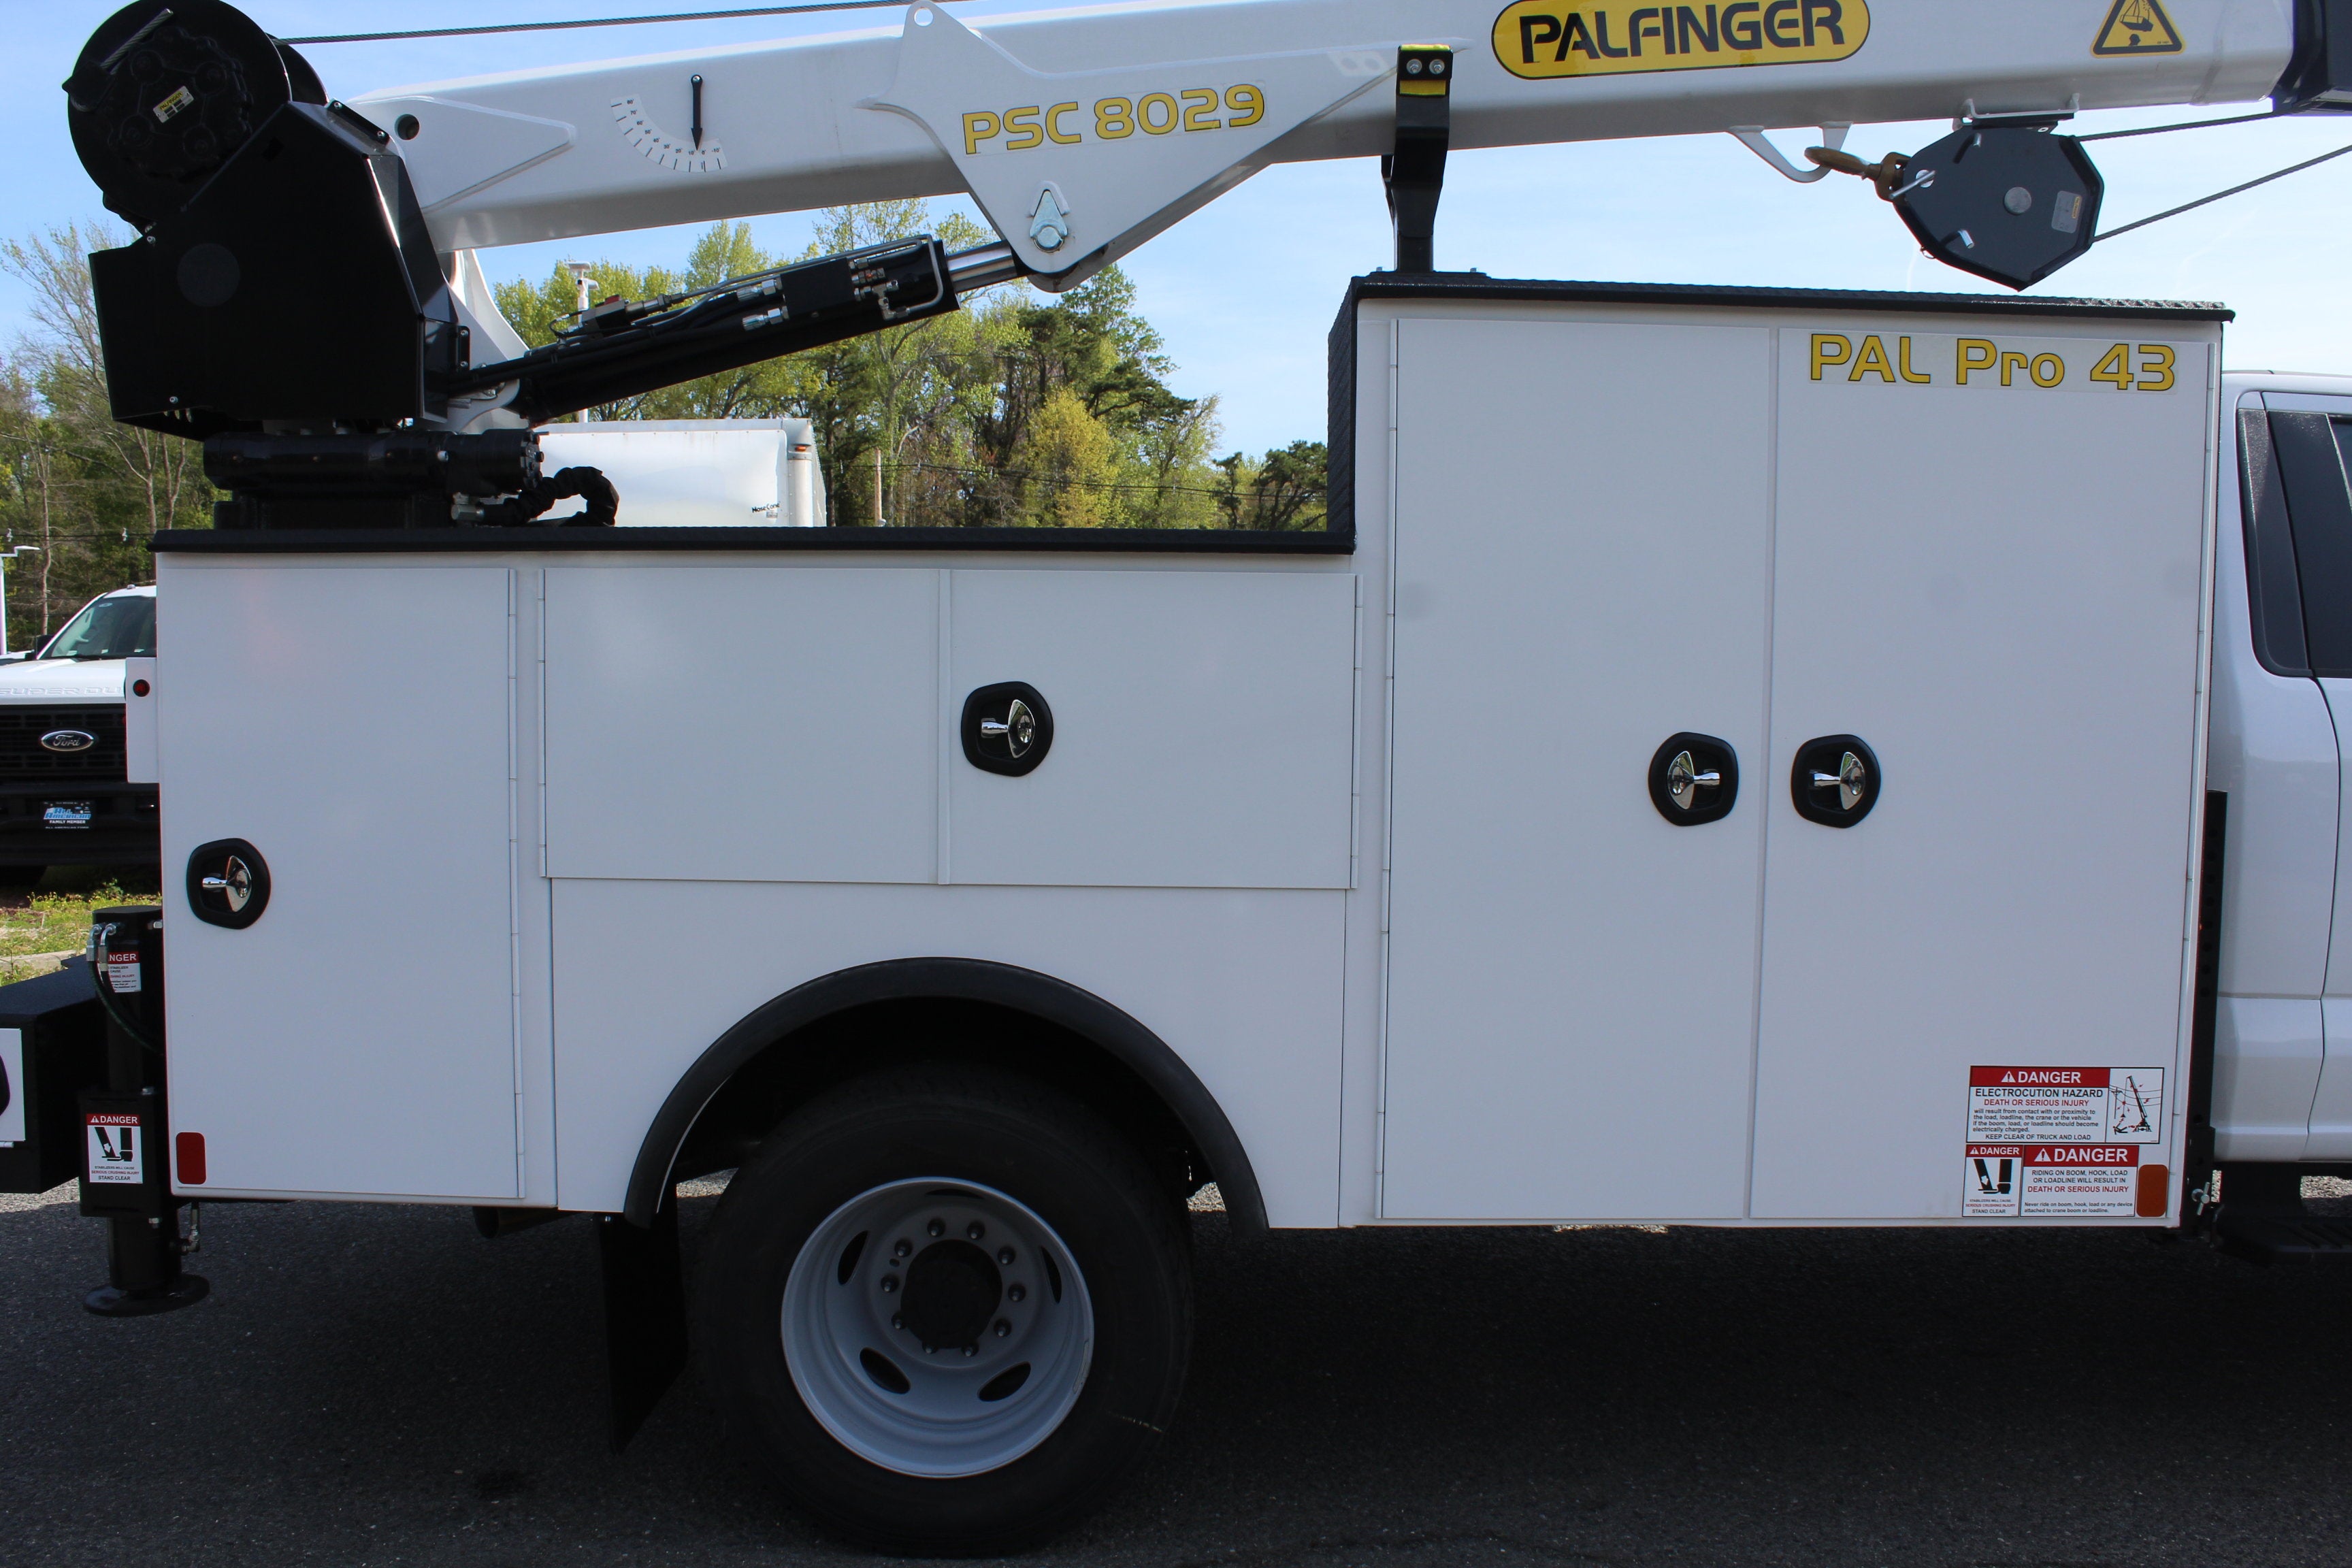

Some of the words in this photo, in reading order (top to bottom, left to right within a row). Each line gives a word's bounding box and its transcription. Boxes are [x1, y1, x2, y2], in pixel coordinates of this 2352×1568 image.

[1520, 0, 1844, 63] PALFINGER
[962, 101, 1081, 154] PSC
[1094, 84, 1264, 140] 8029
[1811, 333, 1931, 384] PAL
[1956, 338, 2065, 387] Pro
[2089, 344, 2175, 391] 43
[84, 687, 120, 696] DU
[52, 734, 80, 747] Ford
[109, 953, 137, 962] NGER
[2018, 1071, 2081, 1083] DANGER
[1975, 1088, 2059, 1097] ELECTROCUTION
[2062, 1089, 2103, 1098] HAZARD
[100, 1115, 137, 1124] DANGER
[2054, 1148, 2128, 1162] DANGER
